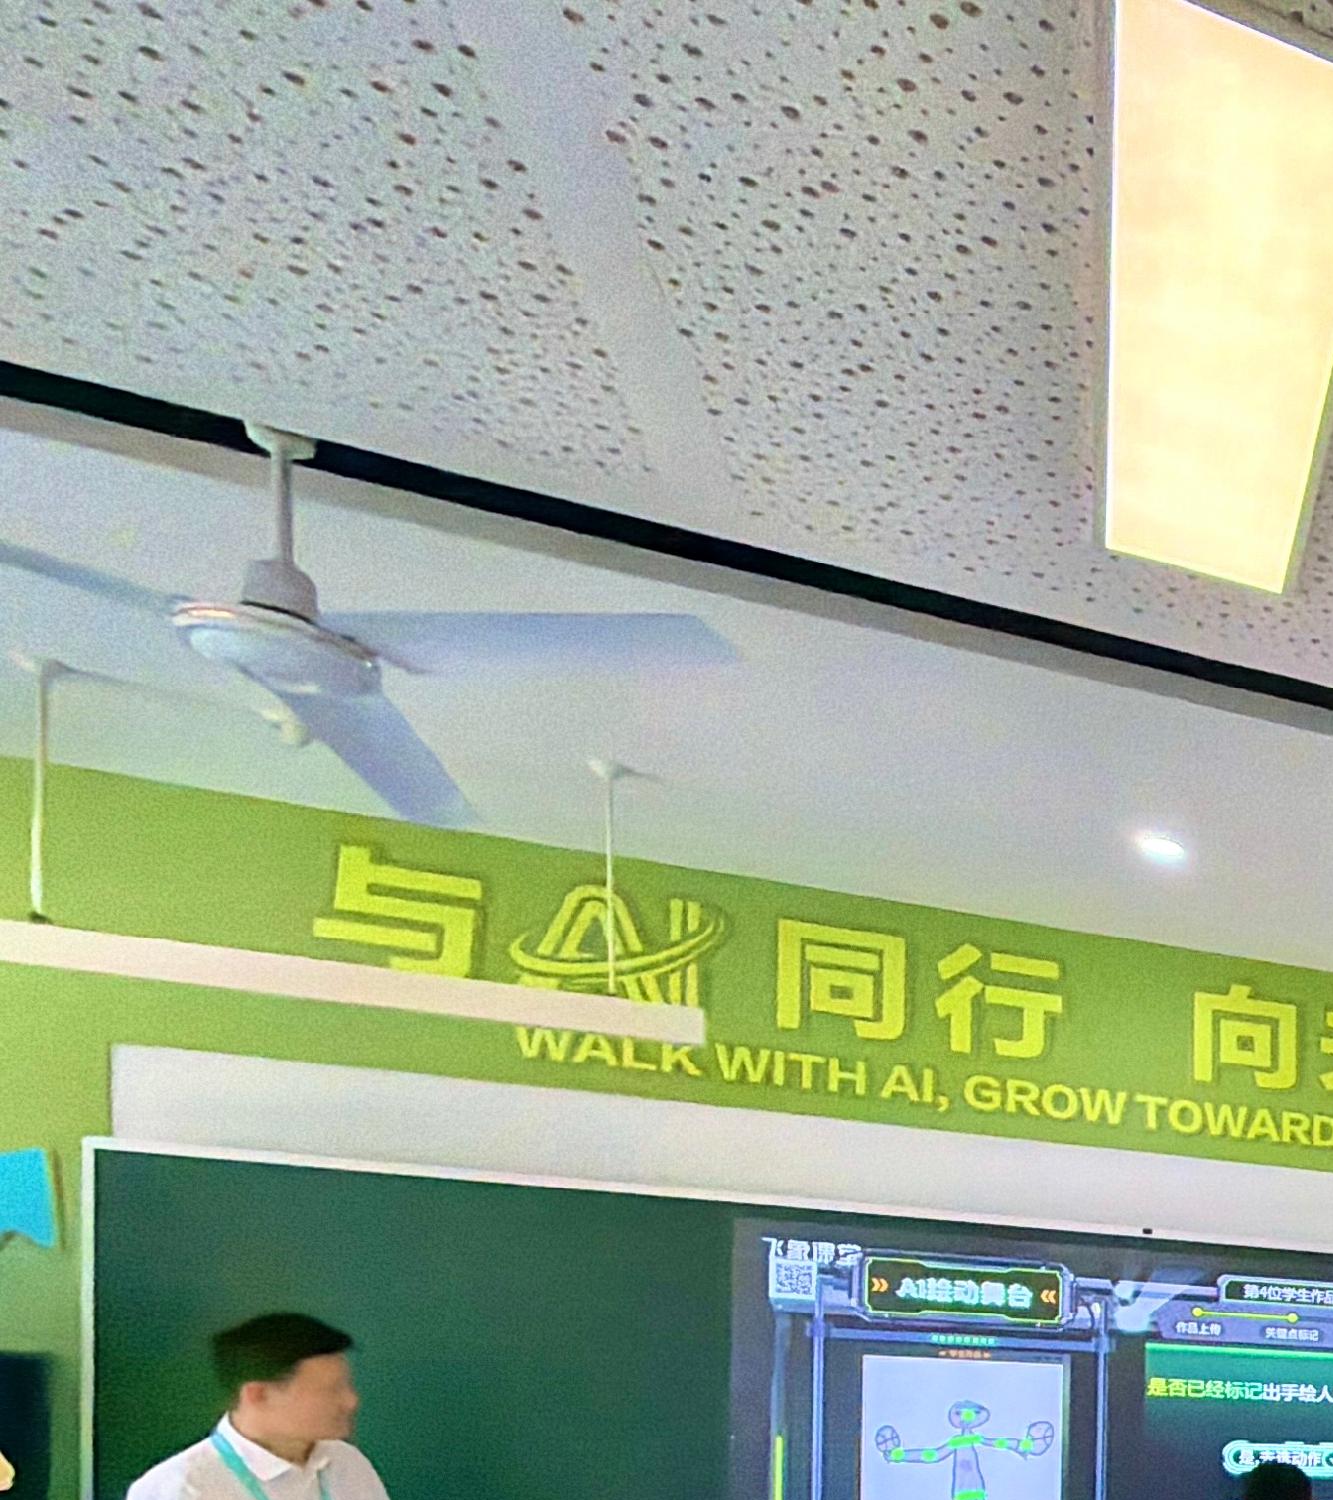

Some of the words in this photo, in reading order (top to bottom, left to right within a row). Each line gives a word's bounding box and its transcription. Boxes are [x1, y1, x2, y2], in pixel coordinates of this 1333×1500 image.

[515, 1026, 703, 1076] WALK
[714, 1043, 867, 1096] WITH
[880, 1065, 951, 1112] AI,
[963, 1074, 1127, 1126] GROW
